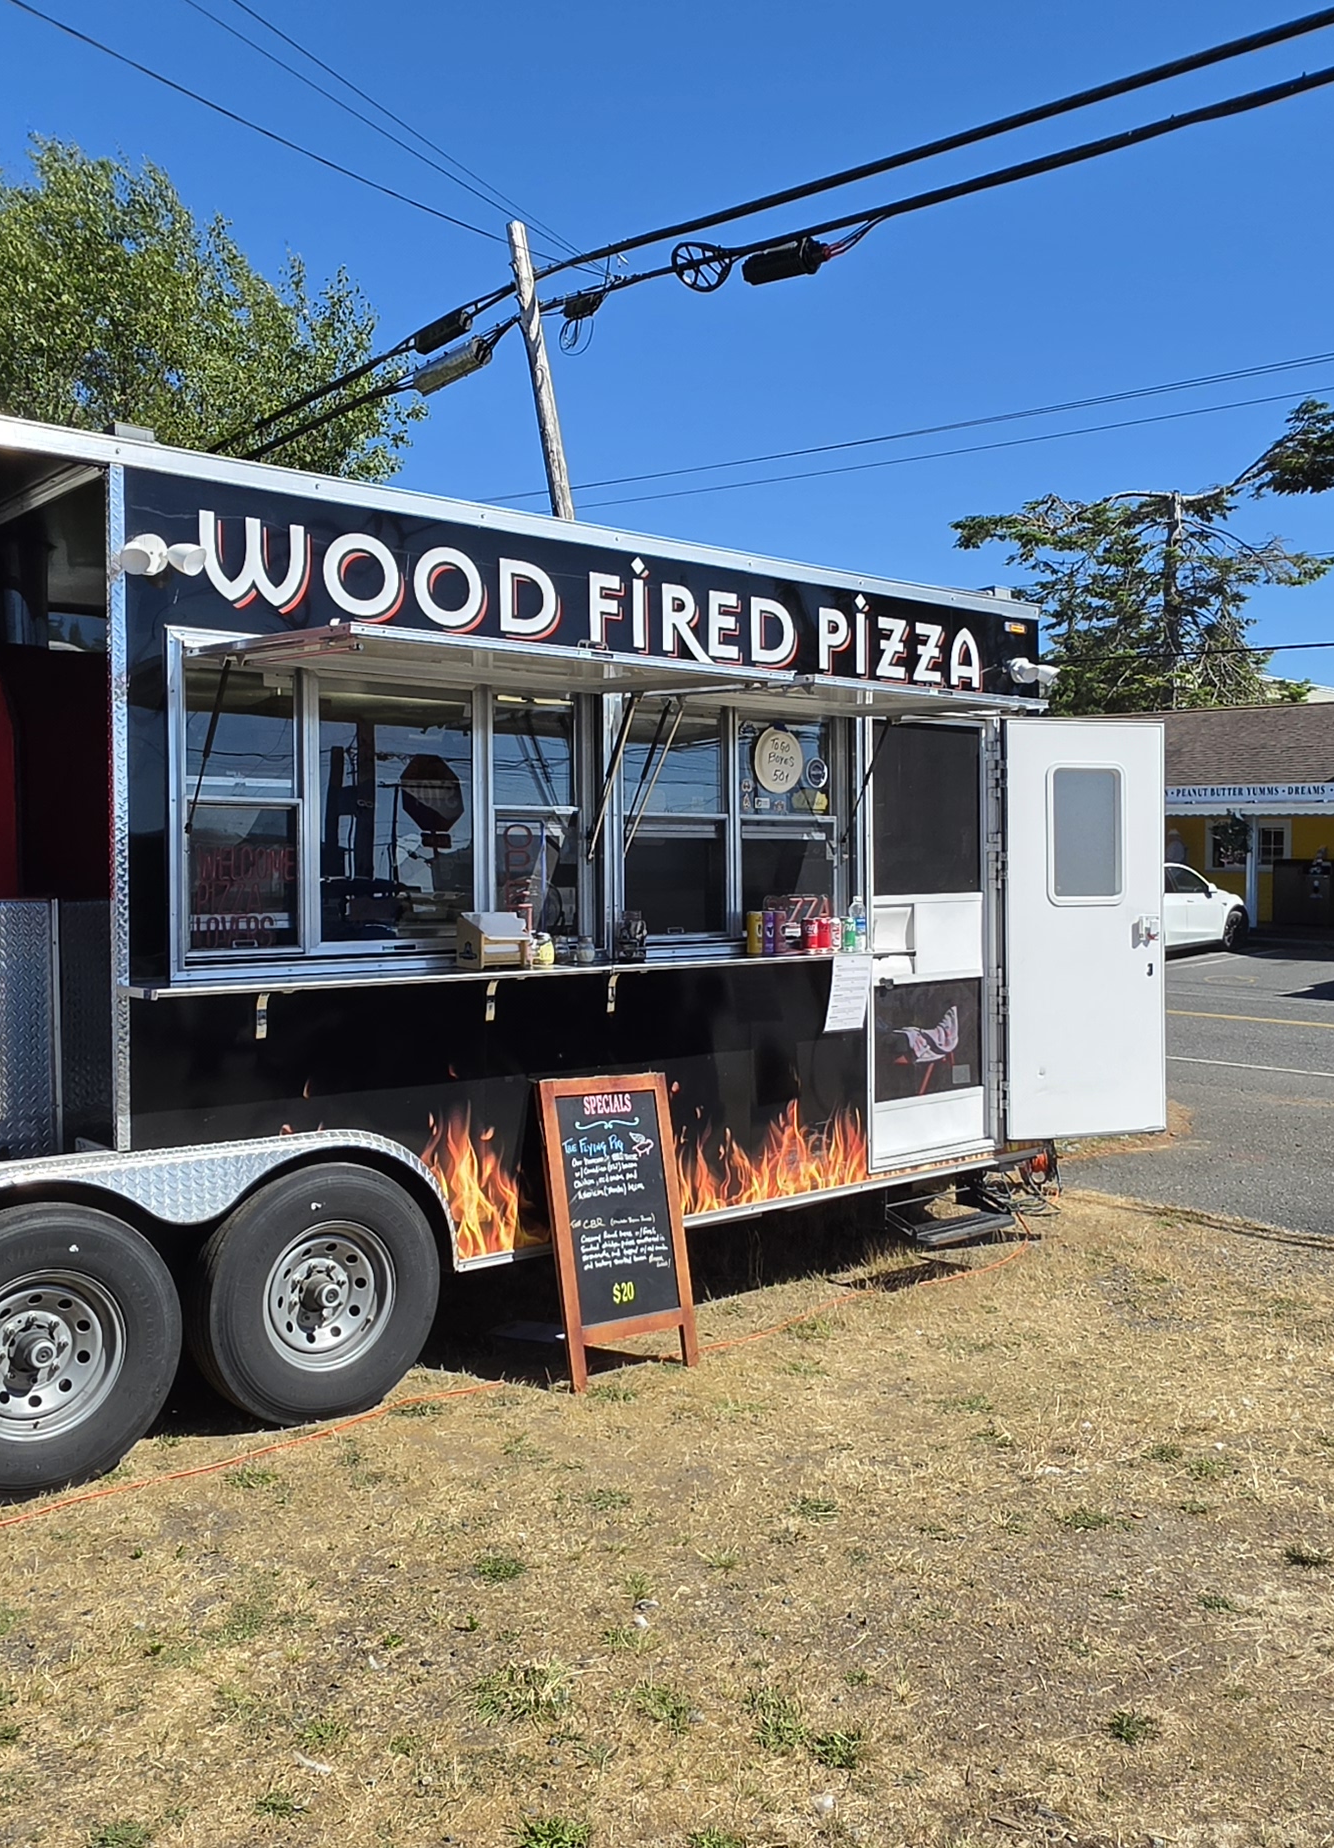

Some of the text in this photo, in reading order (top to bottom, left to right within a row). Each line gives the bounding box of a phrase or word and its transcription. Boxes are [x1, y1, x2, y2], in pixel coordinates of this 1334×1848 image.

[198, 509, 561, 640] WOOD
[1176, 787, 1208, 797] PEANUT
[1210, 787, 1244, 797] BUTTER
[1246, 786, 1279, 796] YUMMS
[1287, 785, 1326, 795] DREAMS
[197, 846, 296, 881] WELCOME
[196, 880, 264, 915] PIZZA
[583, 1093, 632, 1116] SPECIALS
[613, 1281, 635, 1304] $20
